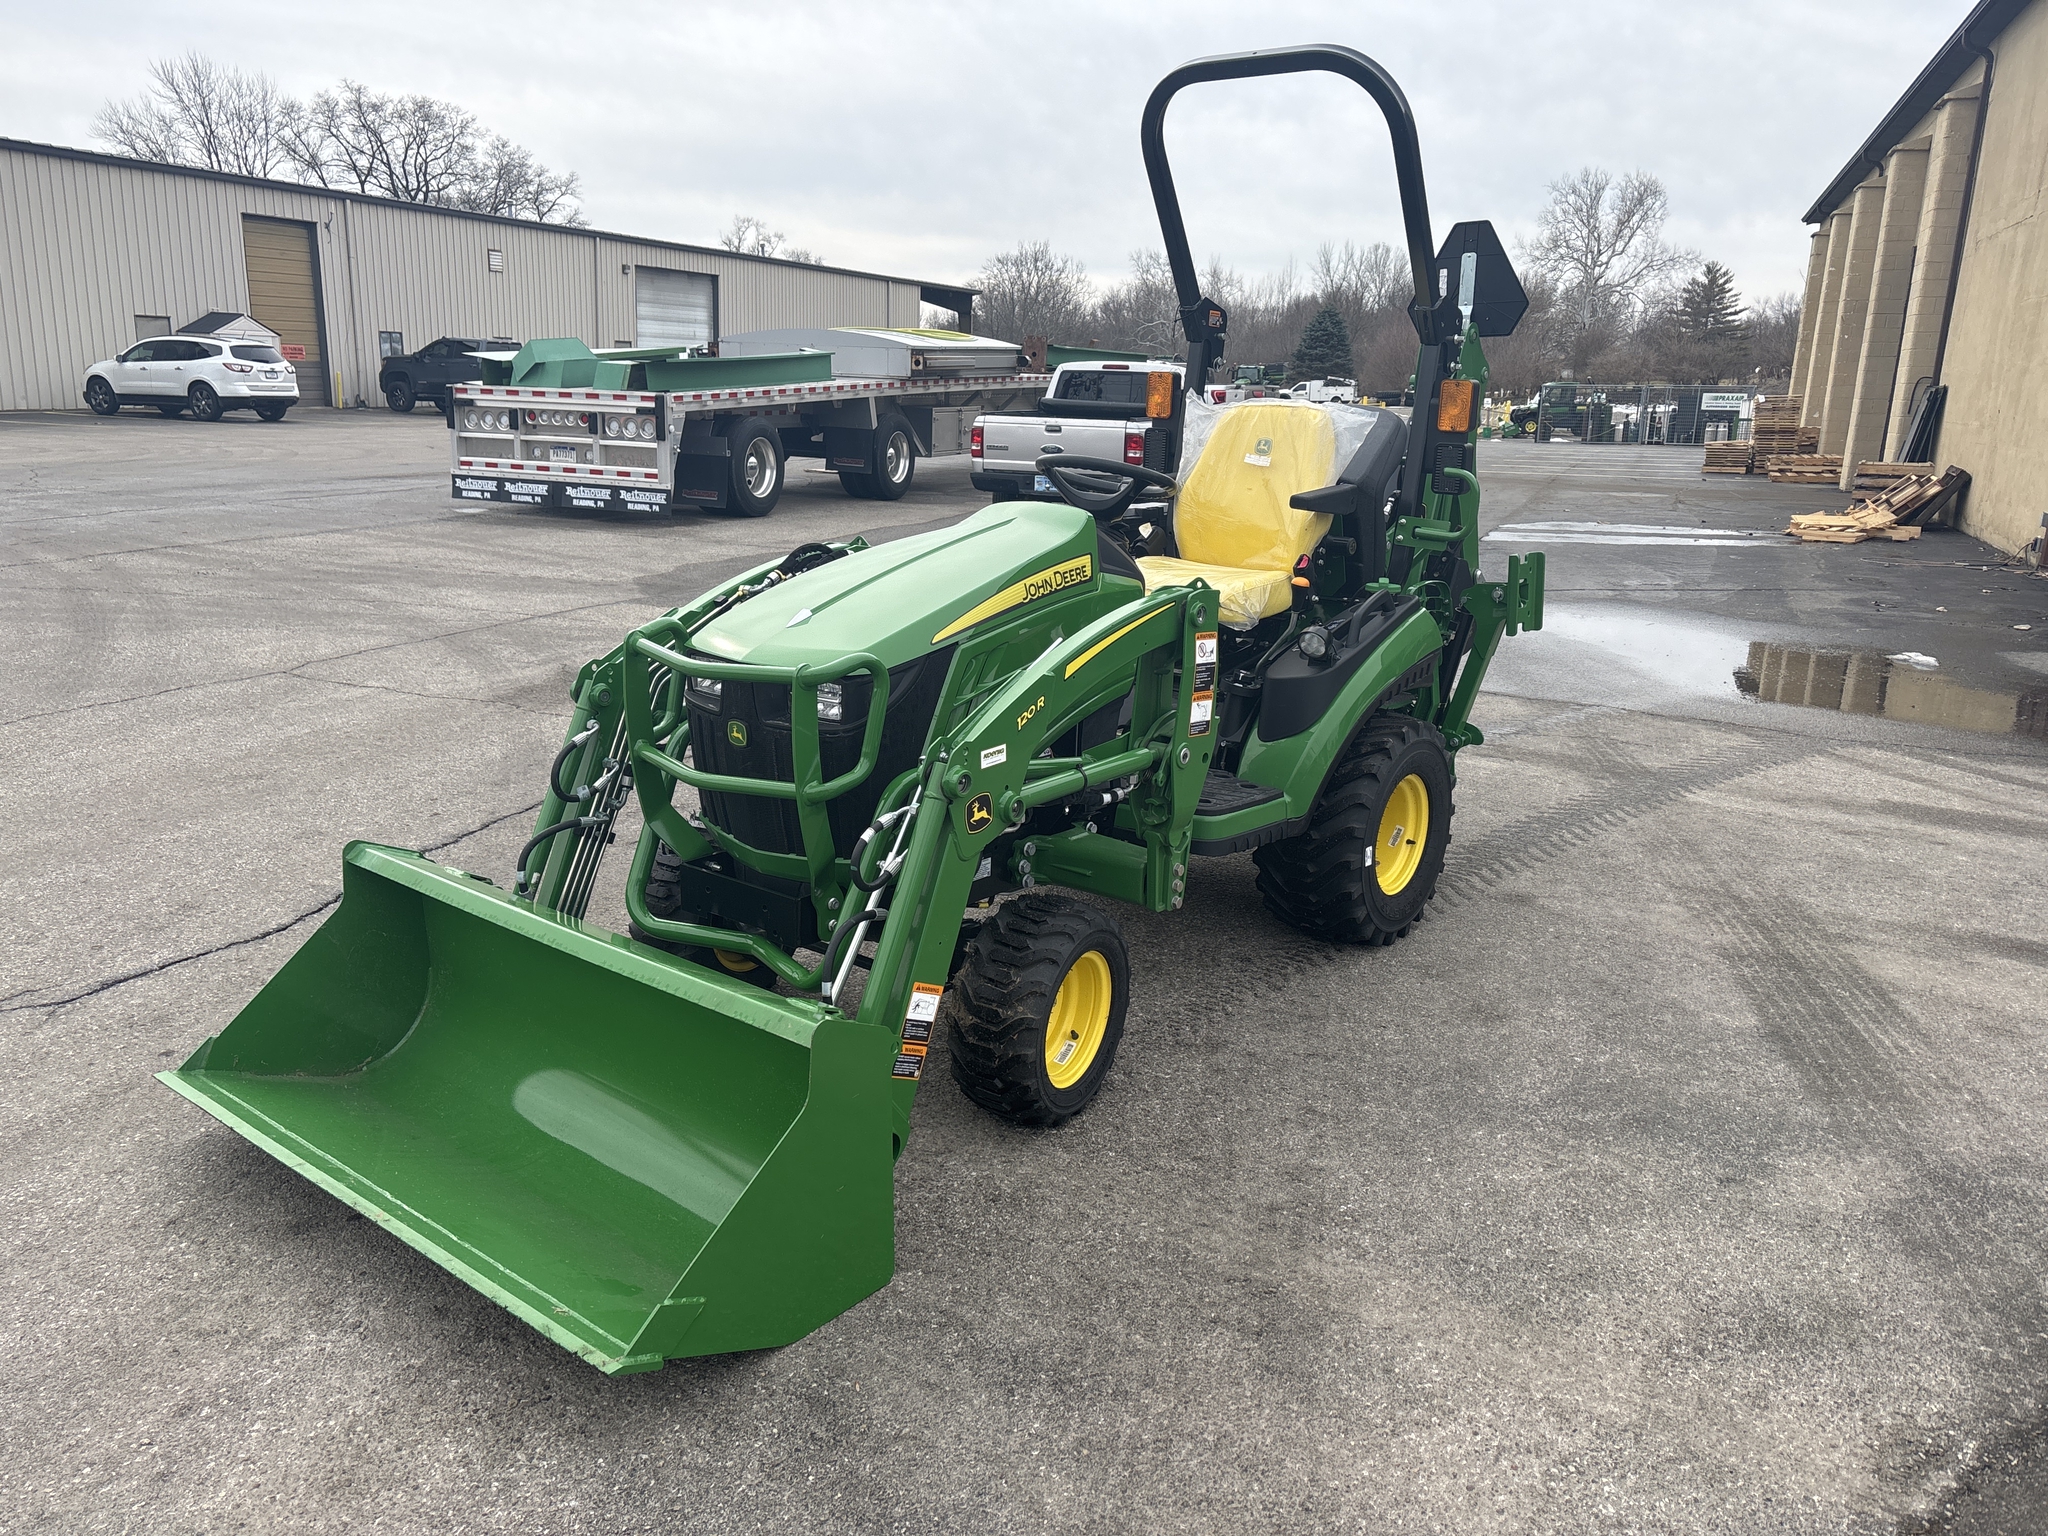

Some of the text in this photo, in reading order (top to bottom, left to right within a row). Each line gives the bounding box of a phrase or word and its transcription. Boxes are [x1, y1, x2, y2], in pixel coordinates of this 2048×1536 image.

[455, 478, 498, 491] Reitnouer
[504, 481, 548, 495] Reitnouer
[462, 490, 483, 499] READING,
[511, 494, 533, 503] READING,
[565, 486, 611, 500] Reitnouer
[619, 489, 667, 504] Reitnouer
[572, 499, 604, 508] READING, PA
[627, 502, 651, 512] READING,
[1022, 565, 1088, 601] JOHN DEERE
[1017, 695, 1045, 731] 120 R
[904, 1047, 924, 1055] WARNING
